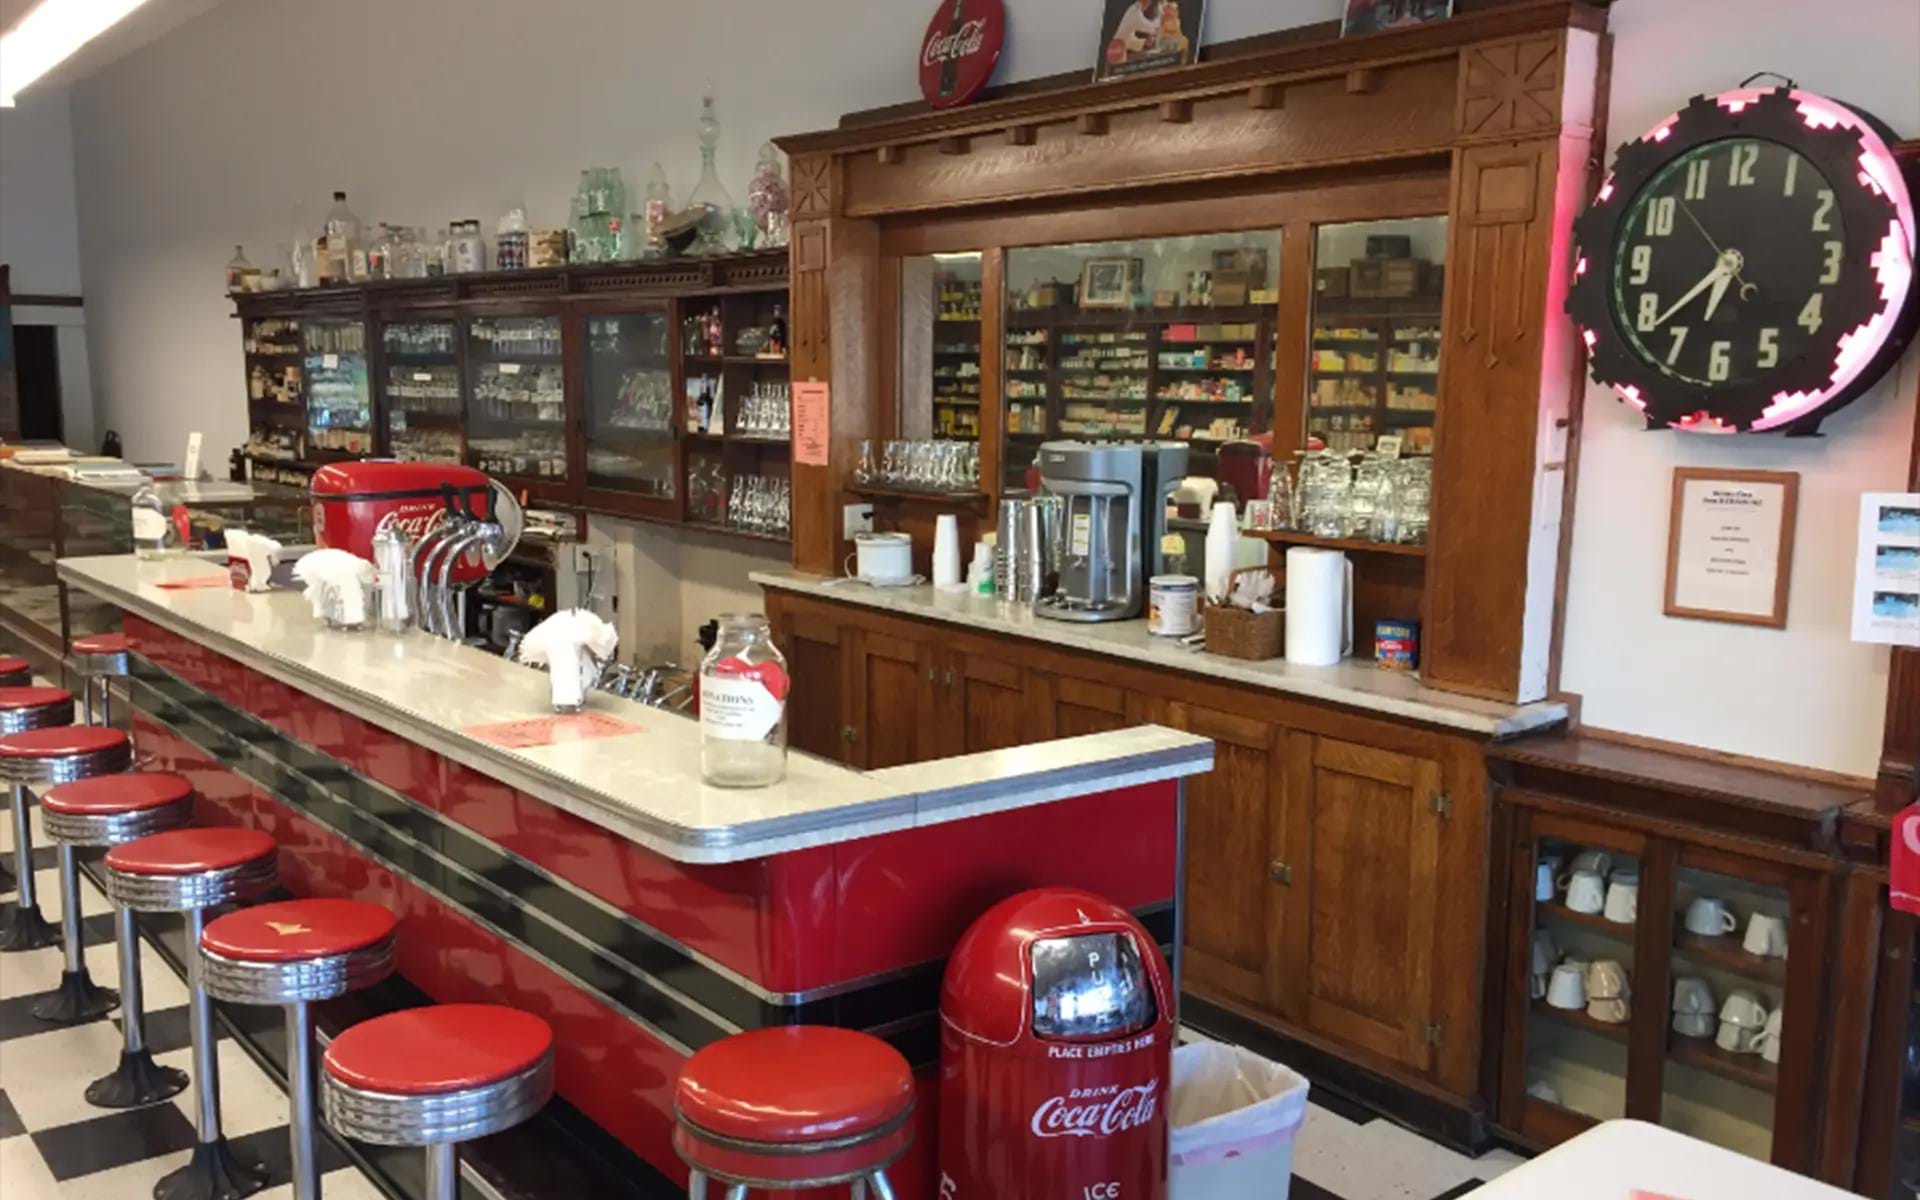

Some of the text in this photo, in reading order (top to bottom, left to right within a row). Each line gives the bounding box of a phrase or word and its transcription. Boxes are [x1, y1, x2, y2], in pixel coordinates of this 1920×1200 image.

[923, 18, 986, 66] Coca-Cola
[1684, 159, 1710, 200] 11
[1728, 144, 1759, 187] 12
[1783, 153, 1798, 197] 1
[1645, 197, 1677, 237] 10
[1811, 189, 1835, 232] 2
[1629, 245, 1652, 285] 9
[1818, 240, 1844, 285] 3
[1637, 292, 1659, 332] 8
[1797, 292, 1824, 335] 4
[1666, 326, 1689, 366] 7
[1707, 340, 1731, 382] 6
[1756, 327, 1780, 368] 5
[1048, 1045, 1083, 1059] PLACE
[1031, 1077, 1159, 1138] Coca-Cola
[1069, 1084, 1119, 1099] DRINK
